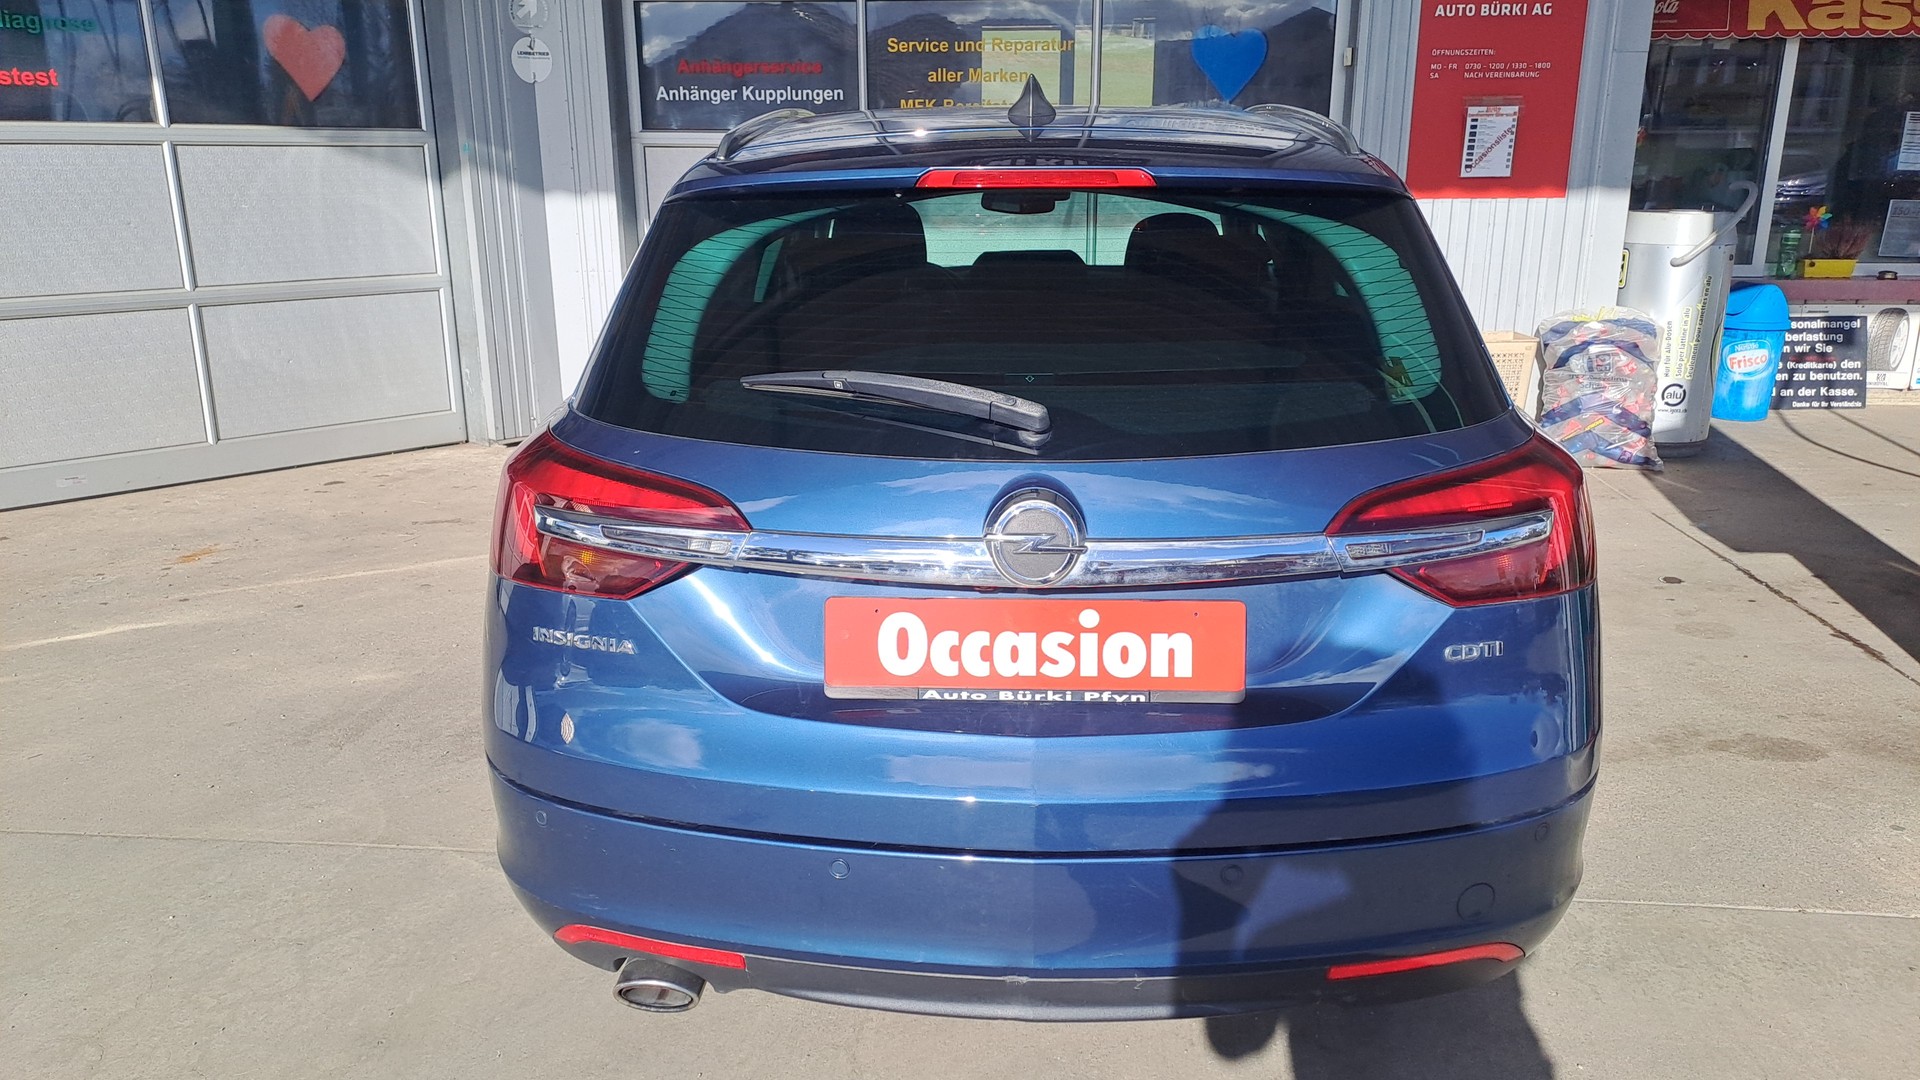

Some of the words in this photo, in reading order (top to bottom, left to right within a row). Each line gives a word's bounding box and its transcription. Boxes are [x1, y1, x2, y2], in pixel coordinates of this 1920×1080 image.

[1435, 4, 1475, 17] AUTO
[1480, 1, 1527, 16] BÜRKI
[1532, 3, 1552, 15] AG
[887, 38, 949, 53] Service
[954, 38, 986, 52] und
[992, 38, 1075, 55] Reparatur
[1431, 48, 1496, 56] ÖFFNUNGSZEITEN:
[677, 59, 823, 77] Anhängerservice
[927, 68, 964, 83] aller
[968, 68, 1028, 83] Marken
[1464, 71, 1484, 79] NACH
[656, 86, 738, 104] Anhänger
[742, 86, 844, 104] Kupplungen
[1794, 344, 1811, 353] wir
[1815, 342, 1833, 353] Sie
[1729, 354, 1768, 369] Frisco
[1787, 361, 1837, 370] (Kreditkarte)
[1840, 359, 1861, 369] den
[1792, 373, 1806, 381] zu
[1809, 371, 1863, 381] benutzen.
[1665, 390, 1682, 399] alu
[1780, 388, 1794, 396] an
[1797, 387, 1817, 396] der
[1820, 387, 1858, 396] Kasse.
[532, 625, 638, 655] INSIGNIA
[877, 608, 1193, 678] Occasion
[1444, 640, 1504, 662] CDTI
[922, 690, 987, 701] Auto
[998, 690, 1072, 702] Bürki
[1084, 691, 1146, 703] Pfyn
